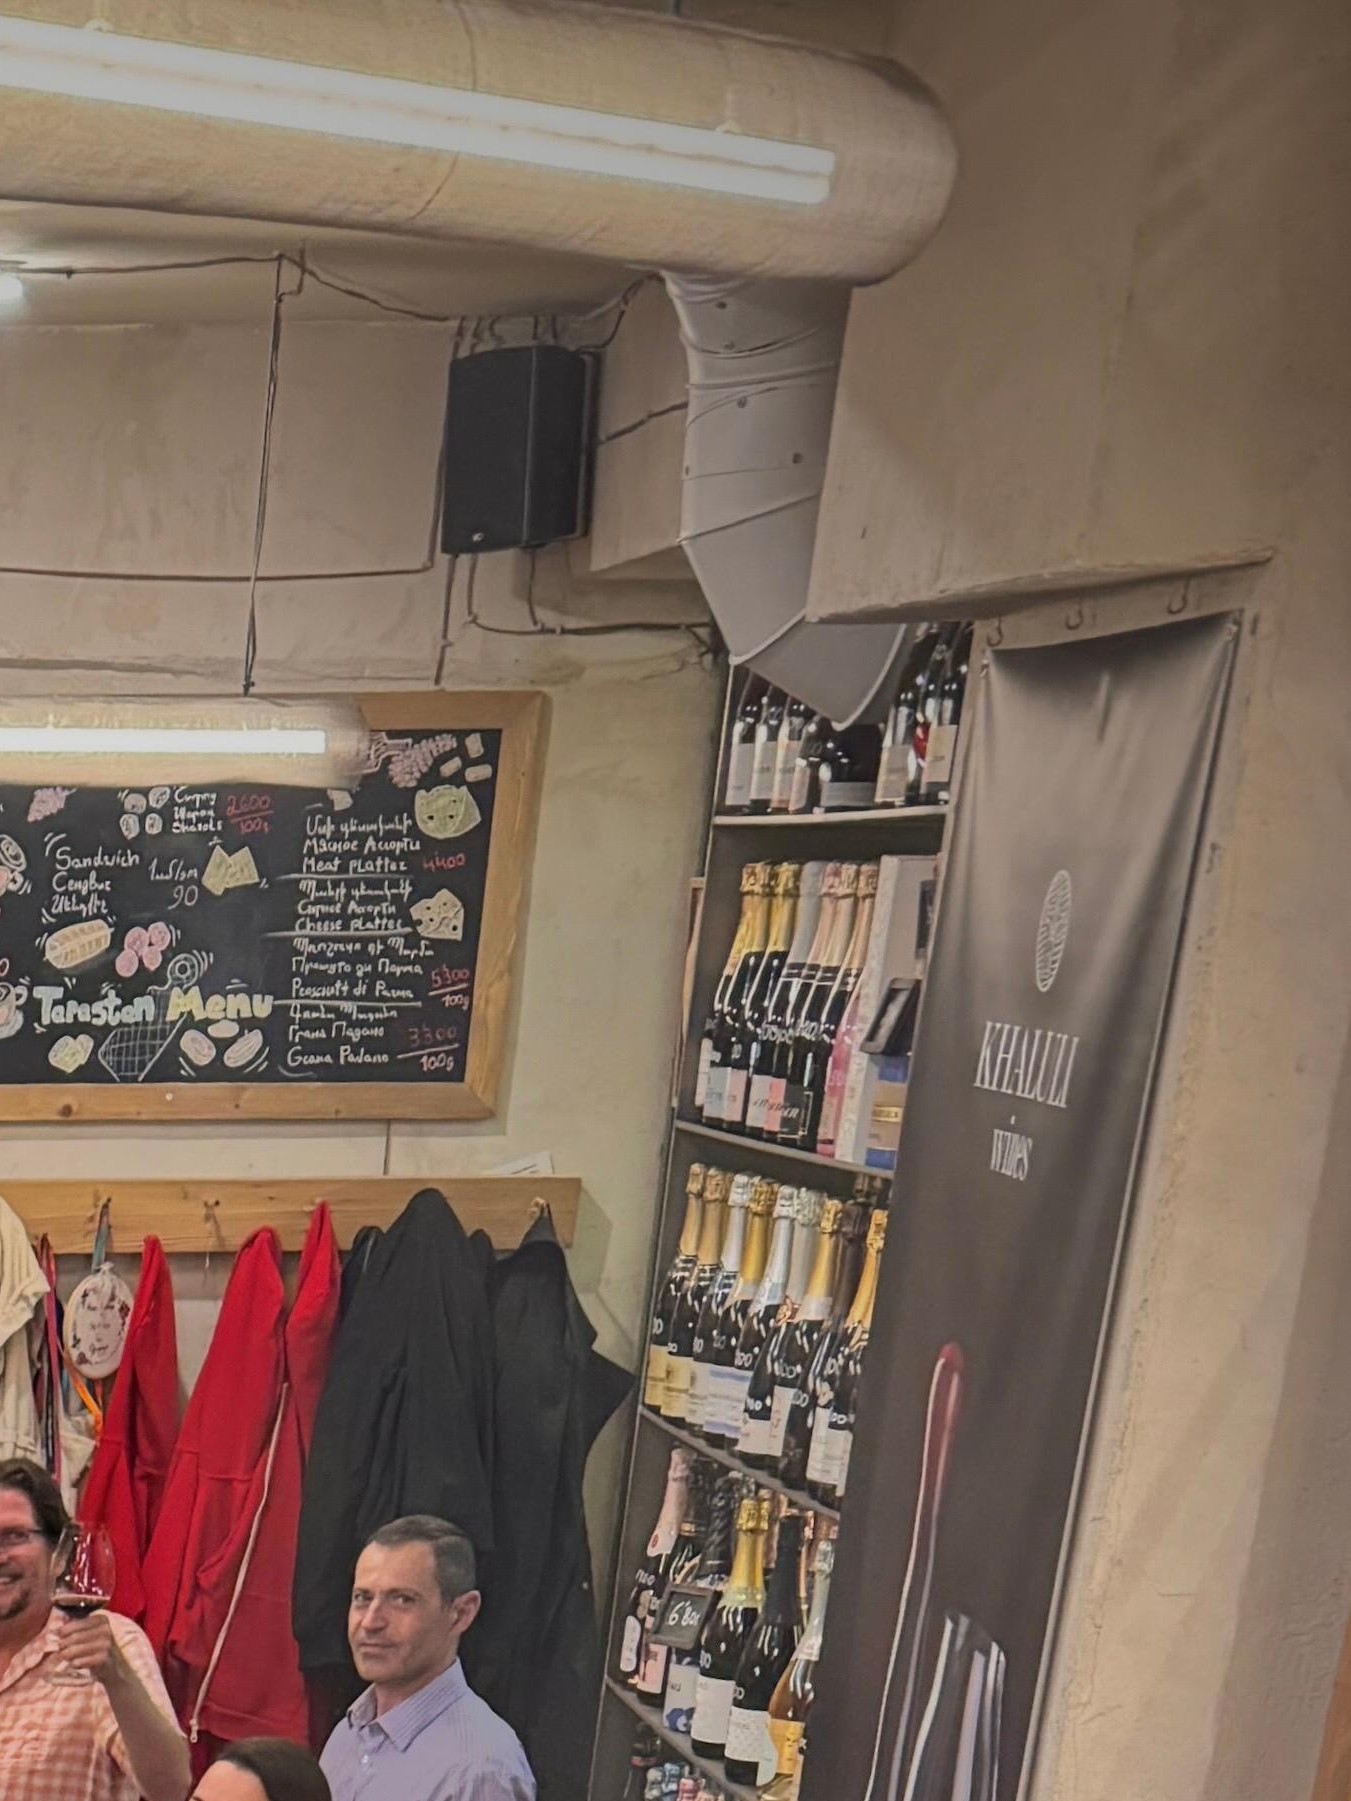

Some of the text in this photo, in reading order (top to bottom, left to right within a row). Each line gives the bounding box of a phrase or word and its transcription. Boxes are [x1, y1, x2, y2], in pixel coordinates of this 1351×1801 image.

[55, 846, 139, 870] Sandwich
[303, 857, 340, 873] Meat
[168, 885, 198, 910] 90
[295, 917, 342, 932] Cheese
[353, 980, 367, 996] di
[165, 985, 274, 1021] Menu
[339, 1045, 389, 1065] Padano
[420, 1054, 454, 1072] 100g
[974, 1021, 1079, 1108] KHALULI
